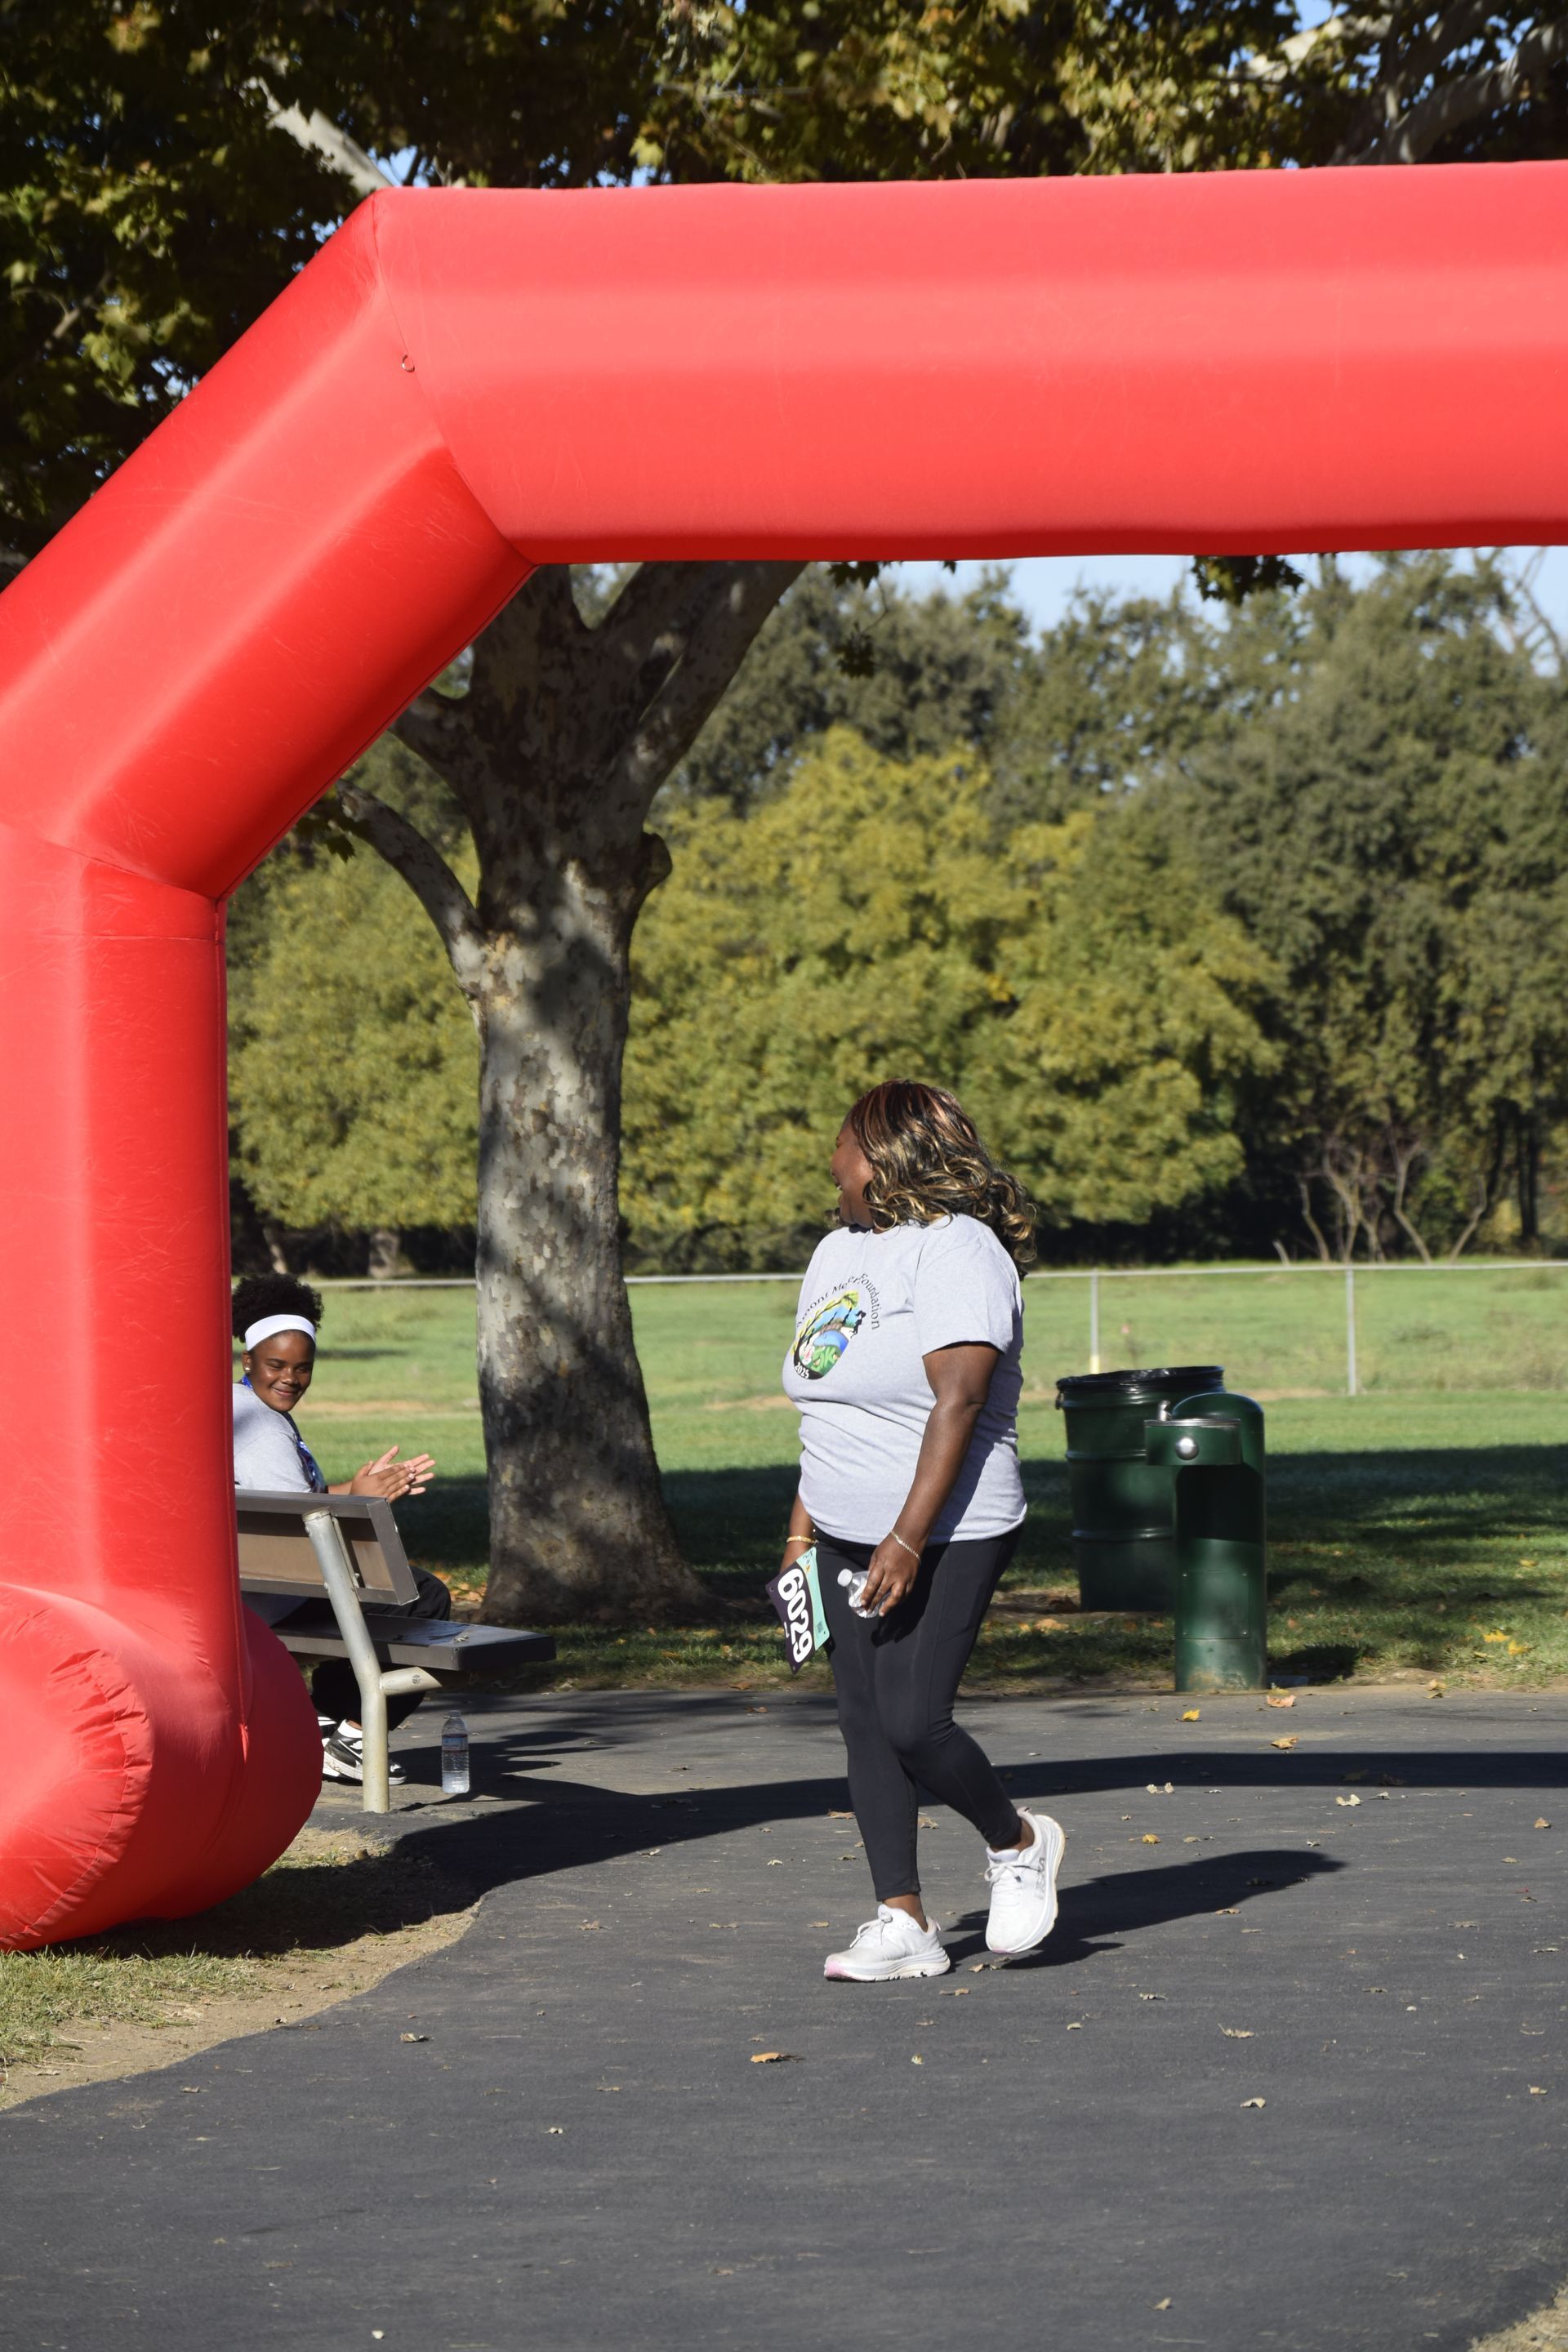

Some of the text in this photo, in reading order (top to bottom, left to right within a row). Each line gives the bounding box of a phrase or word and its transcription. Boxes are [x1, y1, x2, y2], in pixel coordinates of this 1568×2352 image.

[858, 1273, 881, 1330] Foundation
[795, 1361, 809, 1379] 2025
[777, 1568, 813, 1664] 6029
